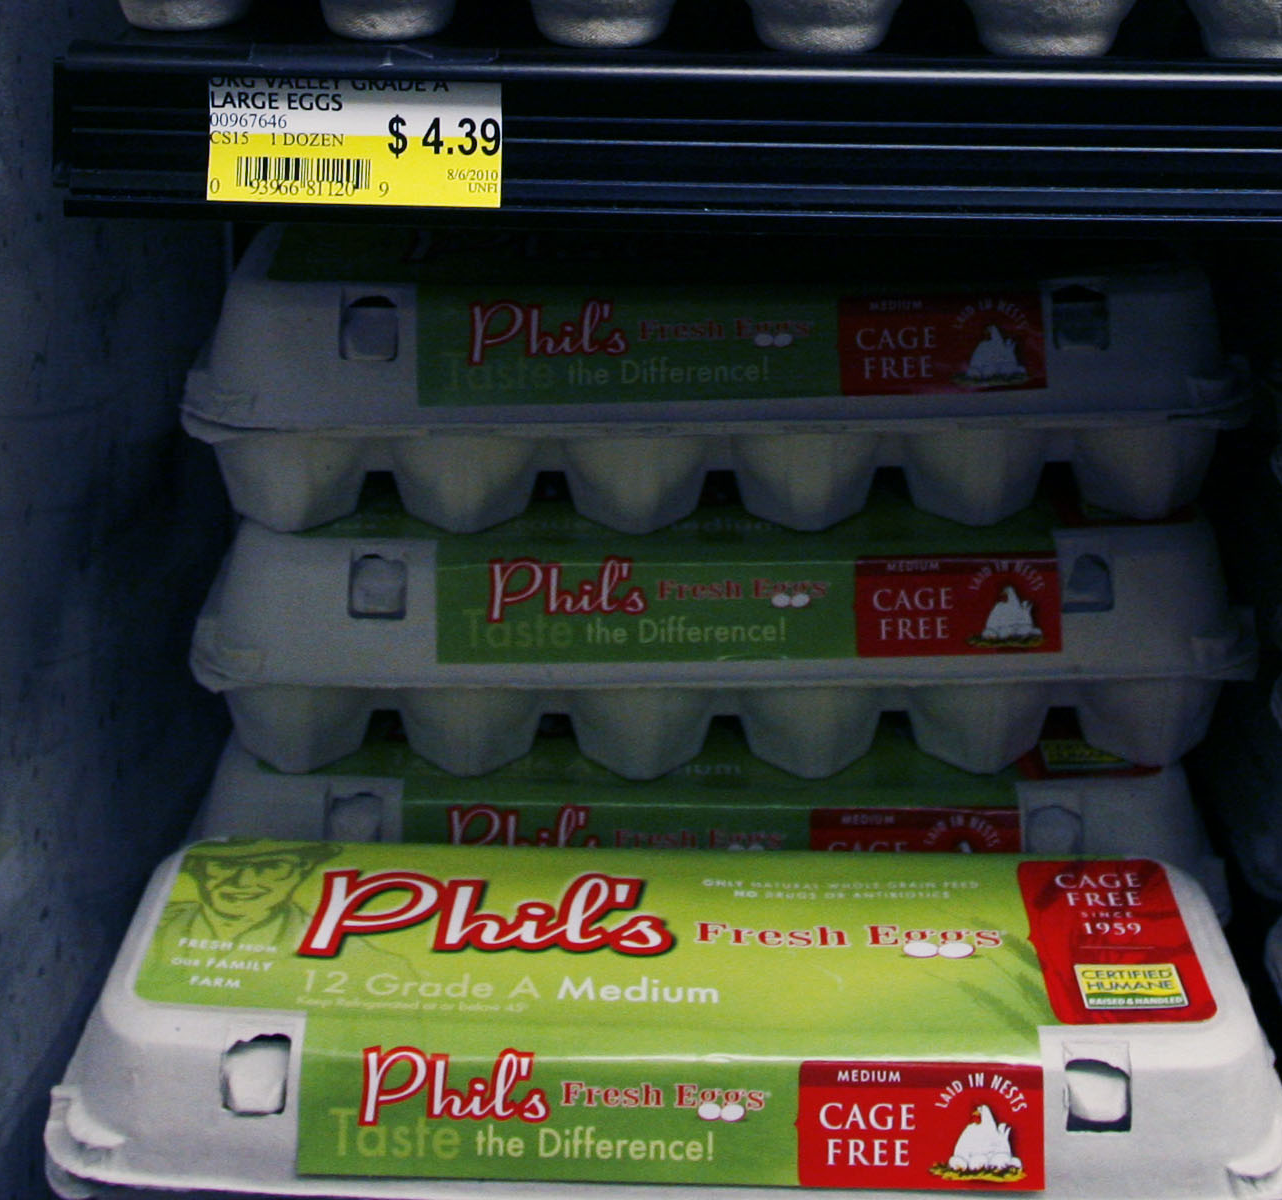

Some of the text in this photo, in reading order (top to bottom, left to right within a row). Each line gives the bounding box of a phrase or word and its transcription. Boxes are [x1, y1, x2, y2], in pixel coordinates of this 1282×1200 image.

[209, 90, 344, 112] LARGE EGGS
[208, 111, 288, 130] 00967646
[208, 130, 250, 146] CS15
[282, 132, 346, 148] DOZEN
[387, 114, 501, 159] $ 4.39
[445, 168, 499, 182] 8/6/2010
[467, 181, 499, 194] UNFI
[1054, 872, 1142, 890] CAGE
[296, 868, 677, 958] Phil's
[1066, 891, 1142, 908] FREE
[694, 921, 1003, 954] Fresh Eggs
[1083, 921, 1142, 936] 1959
[302, 969, 720, 1005] 12 Grade A Medium
[357, 1045, 551, 1127] Phil's
[837, 1069, 902, 1084] MEDIUM
[560, 1080, 766, 1114] Fresh Eggs
[933, 1072, 1028, 1114] LAID IN NESTS
[818, 1102, 917, 1132] CAGE
[328, 1106, 715, 1164] Taste the Difference!
[825, 1138, 911, 1168] FREE
